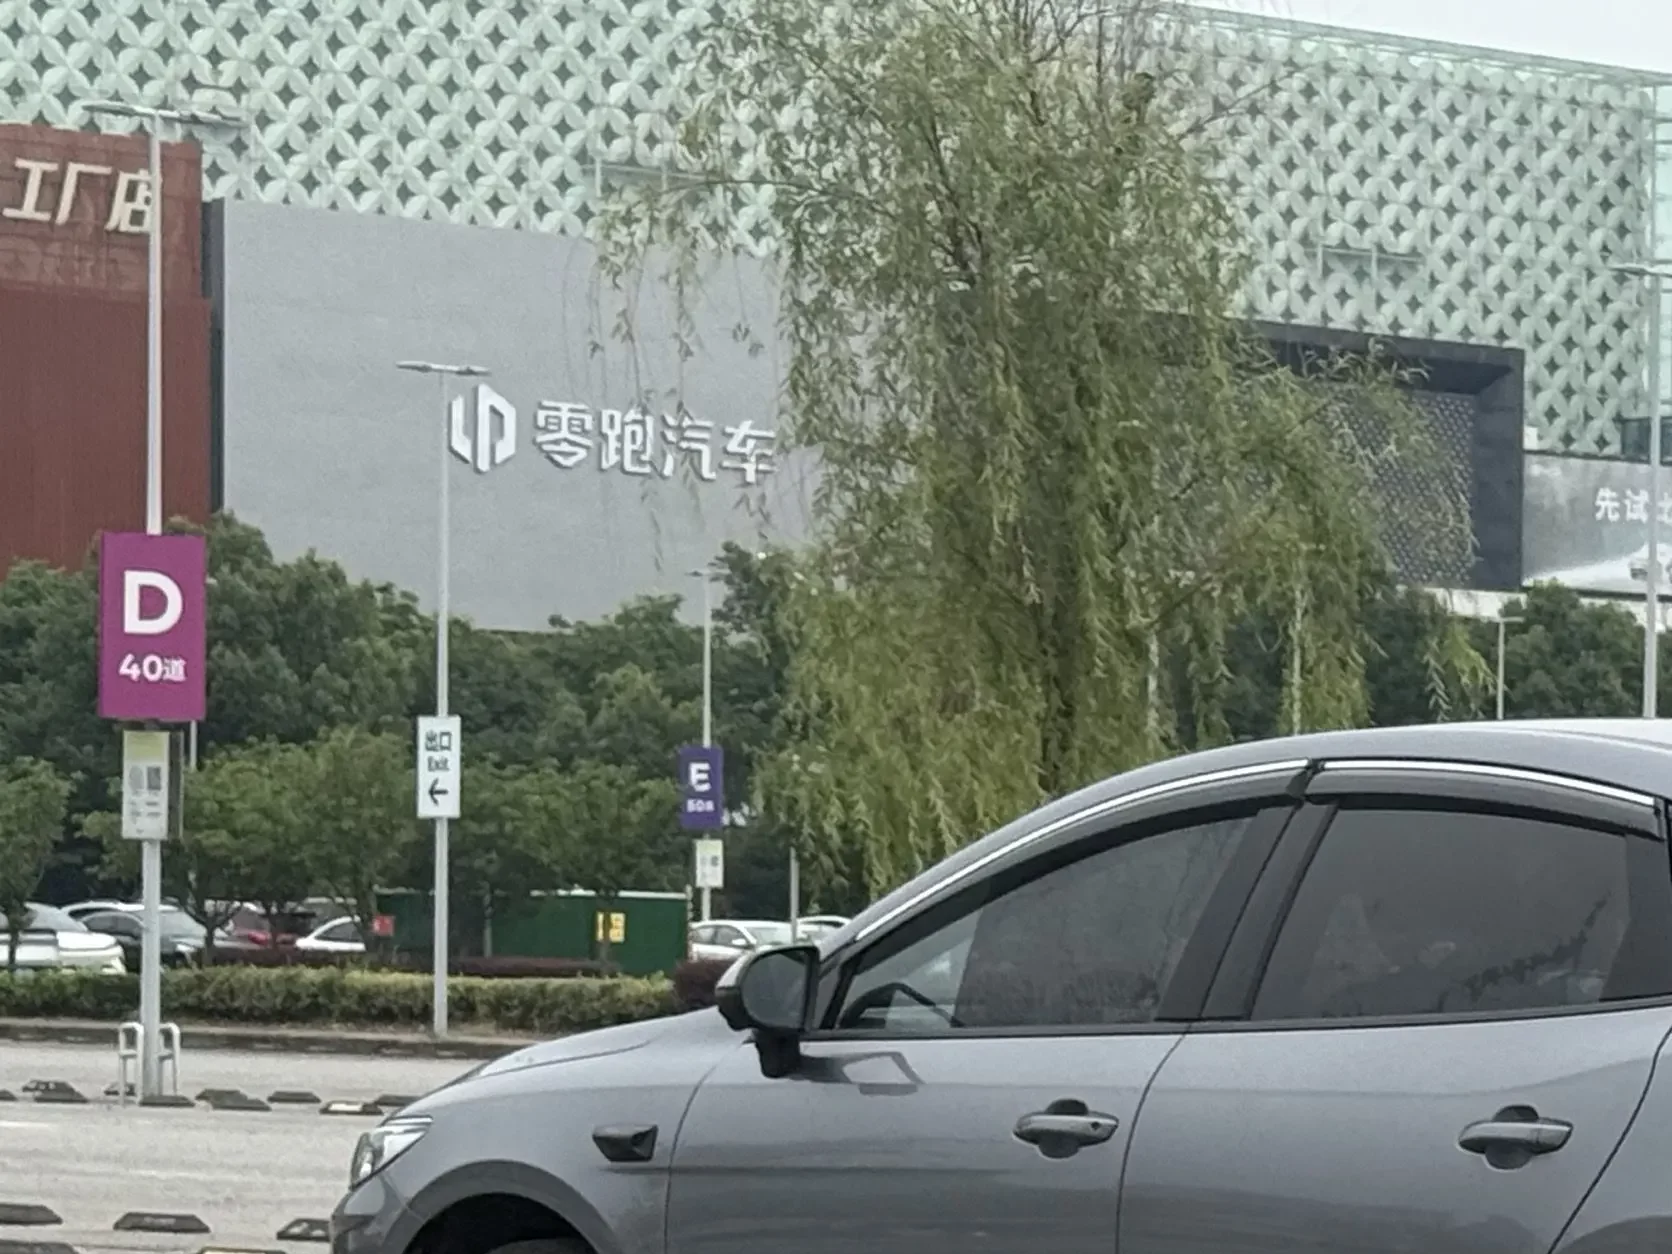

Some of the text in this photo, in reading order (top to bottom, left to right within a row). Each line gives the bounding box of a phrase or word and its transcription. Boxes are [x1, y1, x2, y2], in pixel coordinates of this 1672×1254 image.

[2, 157, 162, 233] 工厂店
[534, 400, 776, 484] 零跑汽车
[124, 569, 183, 634] D
[425, 729, 452, 752] 出口
[689, 762, 711, 792] E
